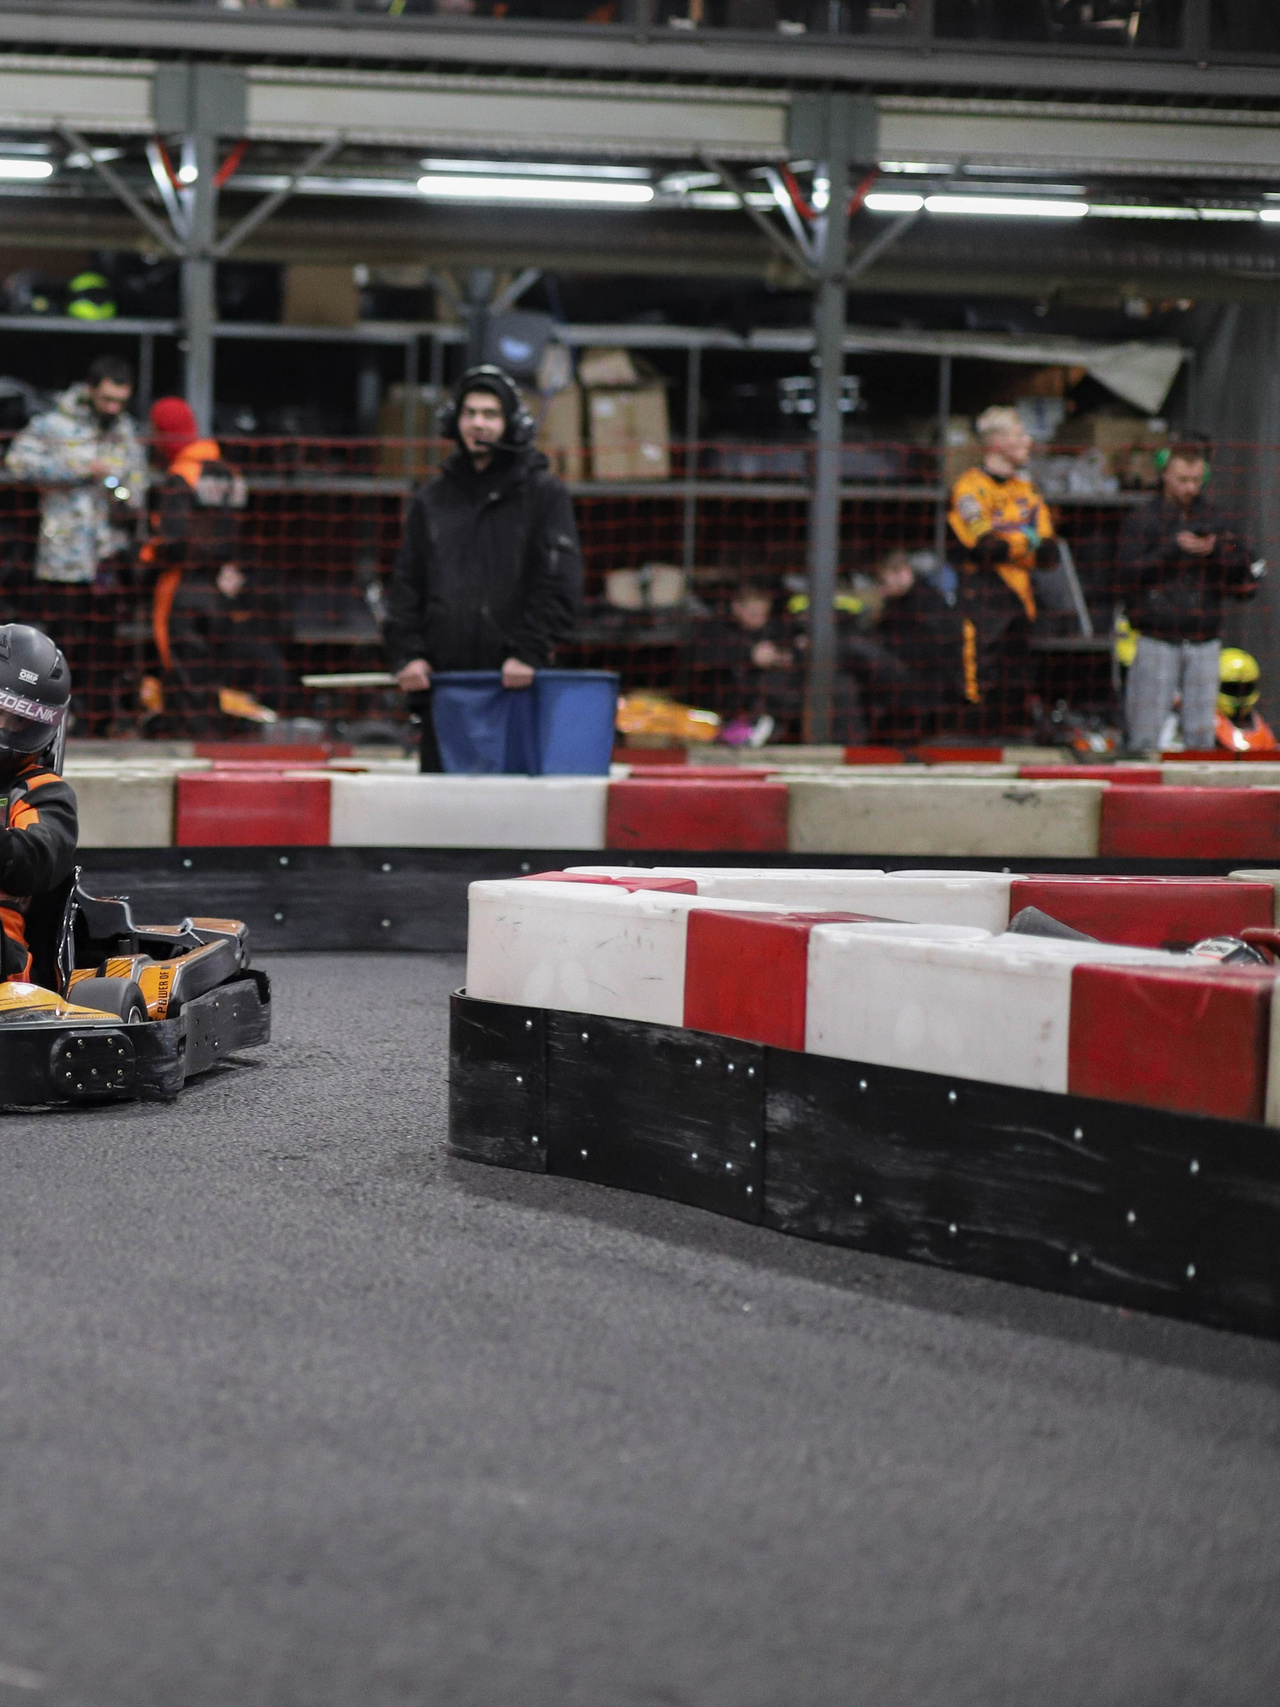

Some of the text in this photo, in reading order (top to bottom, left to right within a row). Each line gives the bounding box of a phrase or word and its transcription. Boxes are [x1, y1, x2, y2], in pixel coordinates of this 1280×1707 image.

[19, 670, 39, 683] OMP
[160, 972, 169, 980] OF
[157, 981, 169, 1014] POWER
